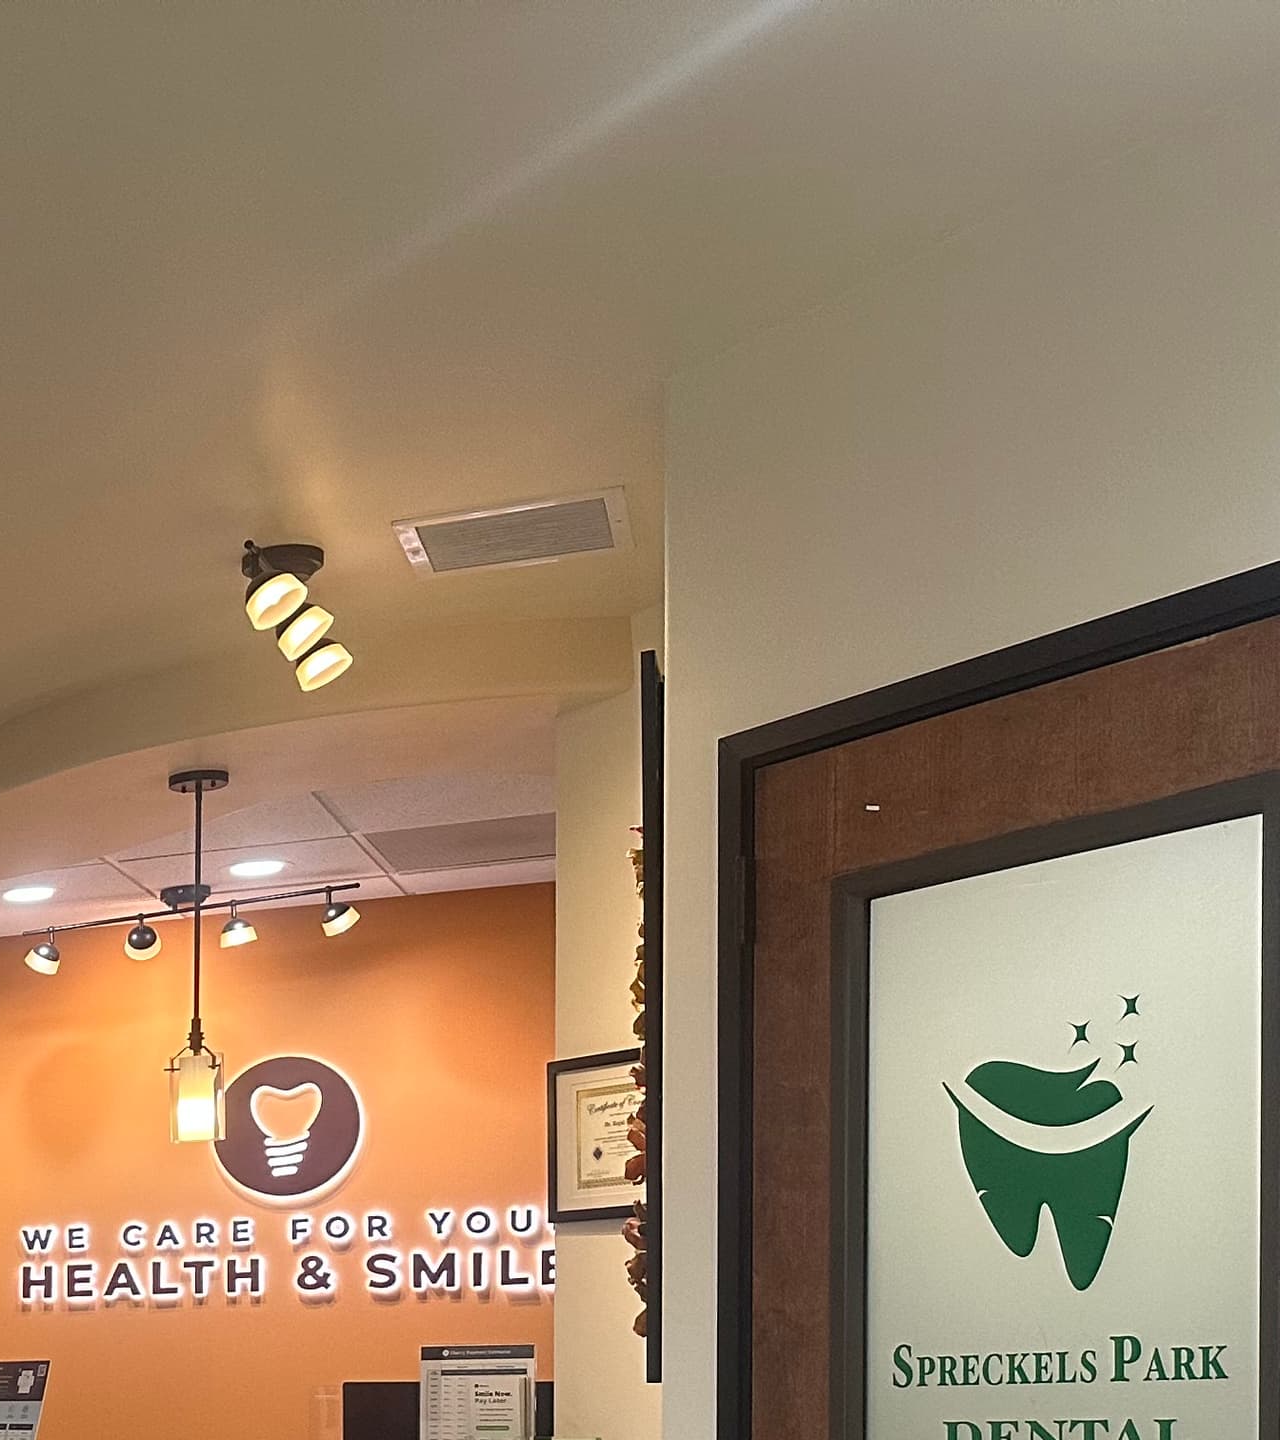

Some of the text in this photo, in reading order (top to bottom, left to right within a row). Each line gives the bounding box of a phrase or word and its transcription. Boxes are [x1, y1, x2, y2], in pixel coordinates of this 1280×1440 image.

[22, 1209, 555, 1250] WE CARE FOR YOU
[22, 1258, 260, 1299] HEALTH
[297, 1255, 331, 1290] &
[892, 1335, 1228, 1388] SPRECKELS PARK
